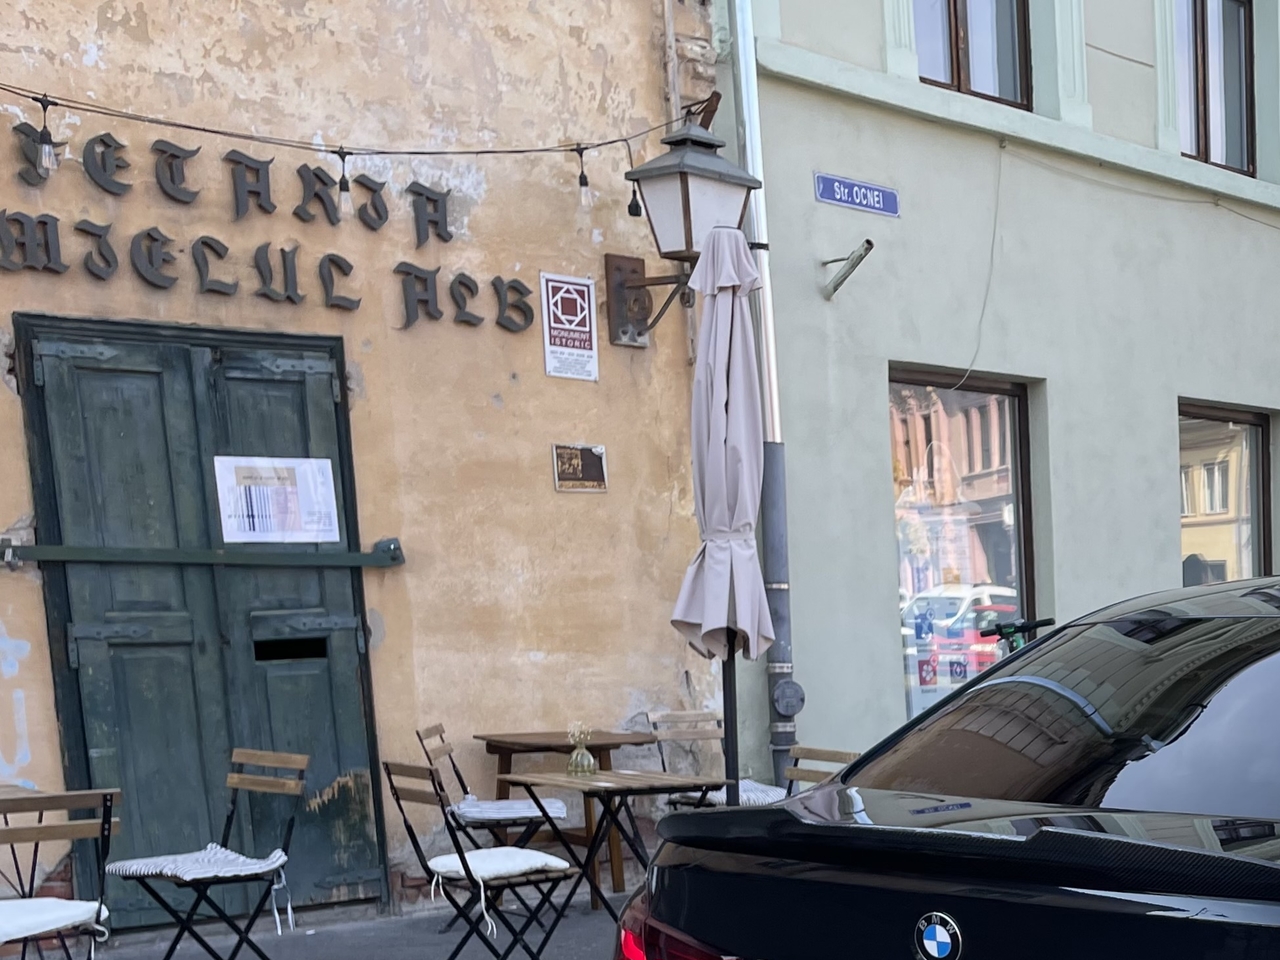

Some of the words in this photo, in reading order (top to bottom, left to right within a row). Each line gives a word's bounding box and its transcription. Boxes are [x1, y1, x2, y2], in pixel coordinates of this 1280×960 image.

[853, 186, 884, 209] OCNEI
[393, 261, 534, 332] ALB
[551, 337, 591, 349] ISTORIC
[919, 915, 956, 934] BMW
